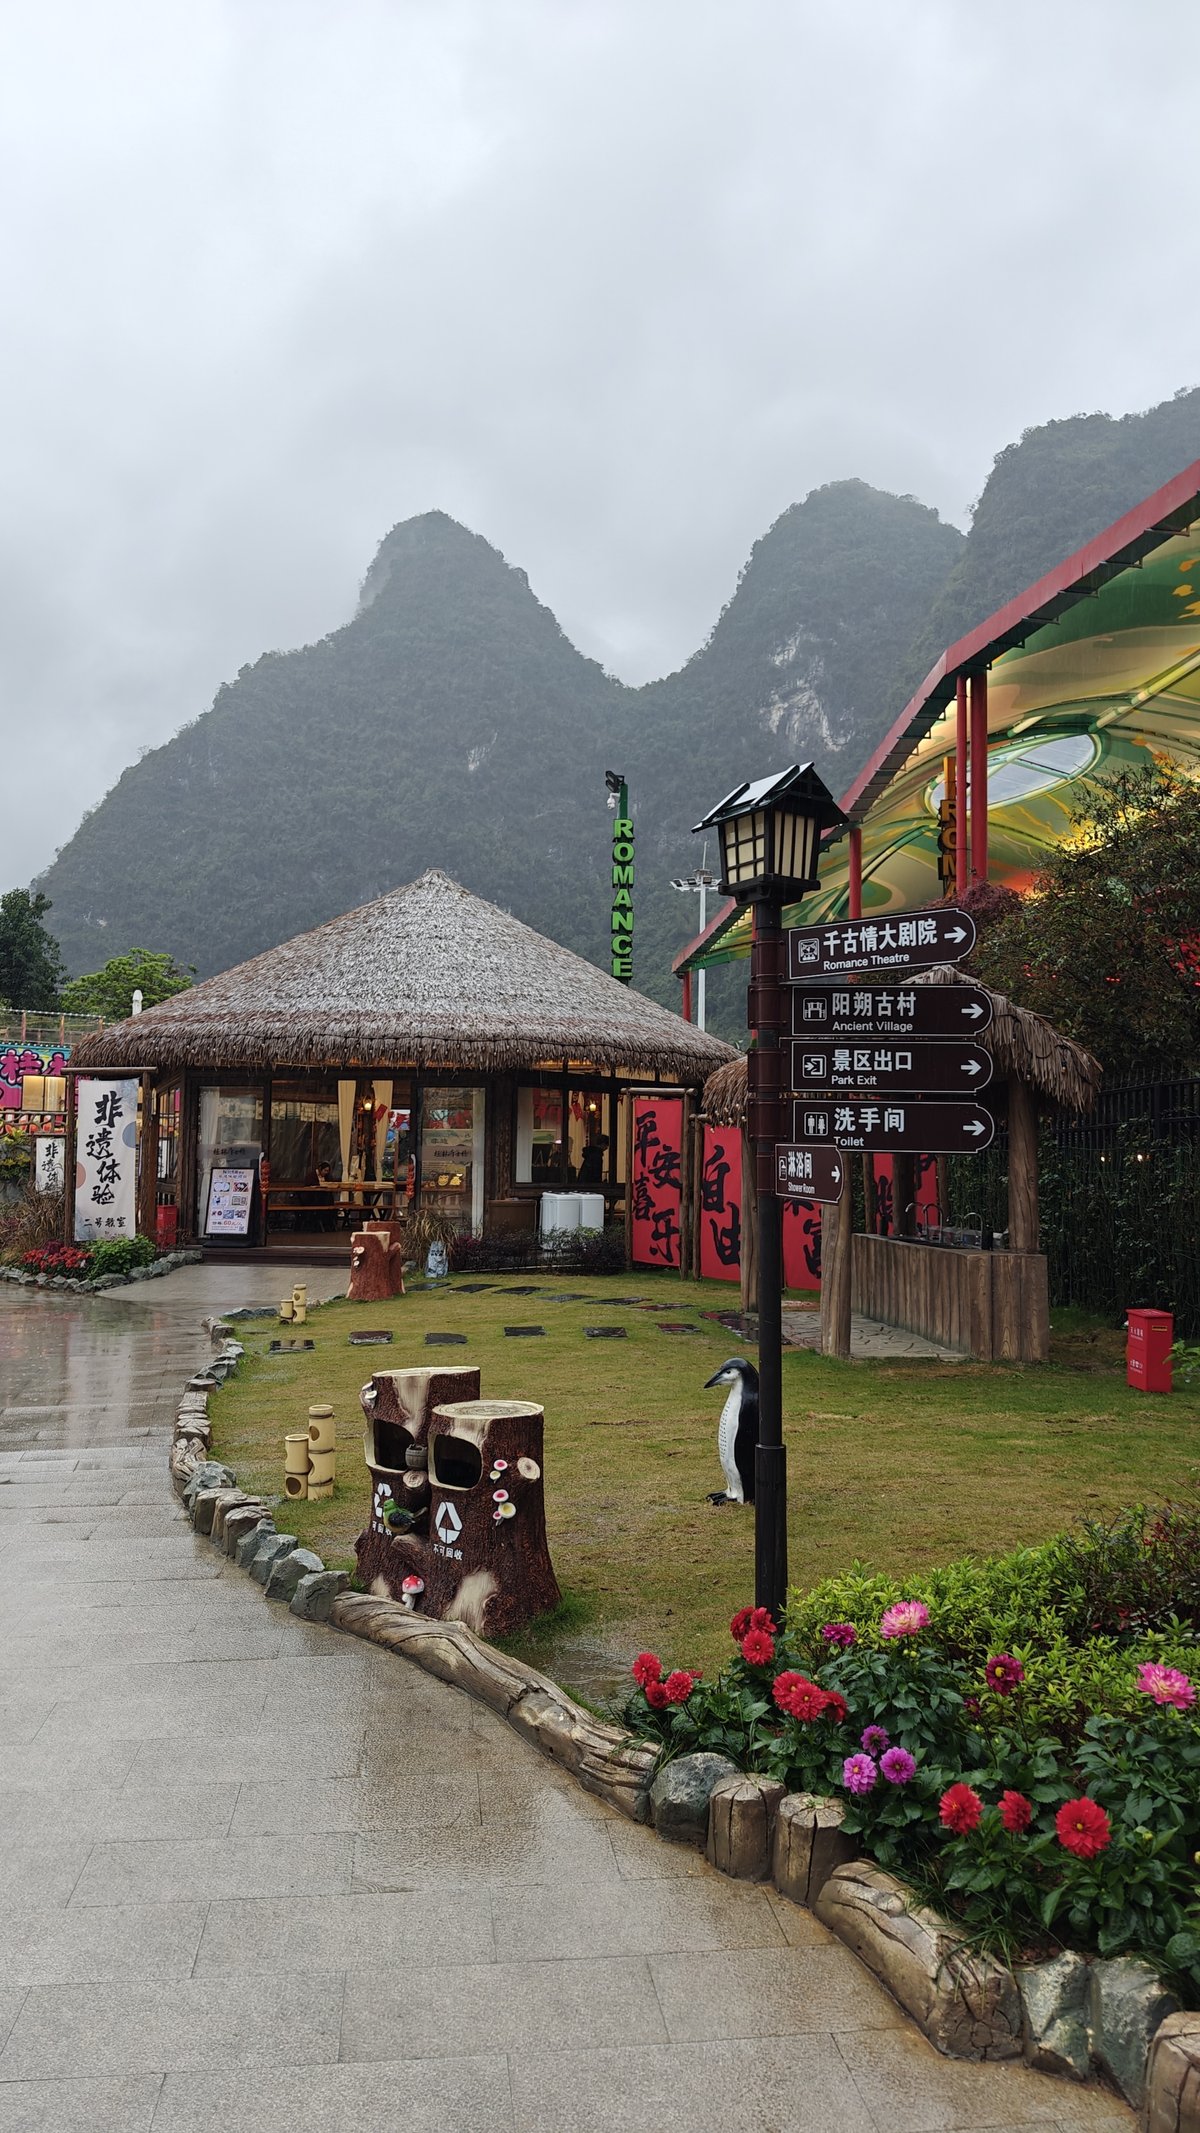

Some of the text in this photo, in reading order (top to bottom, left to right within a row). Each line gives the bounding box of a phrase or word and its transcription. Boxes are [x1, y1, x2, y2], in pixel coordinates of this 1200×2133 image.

[611, 818, 636, 978] ROMANCE
[823, 918, 938, 957] 千古情大剧院
[823, 952, 910, 971] Romance Theatre
[832, 992, 916, 1017] 阳朔古村
[832, 1020, 913, 1033] Ancient Village
[831, 1049, 912, 1072] 景区出口
[831, 1074, 877, 1086] Park Exit
[834, 1107, 905, 1132] 洗手间
[85, 1090, 124, 1205] 非遗体验
[834, 1136, 864, 1147] Toilet
[787, 1151, 813, 1179] 淋浴间
[633, 1110, 681, 1263] 平安喜乐
[83, 1216, 127, 1228] 二号教室
[372, 1520, 393, 1536] 可回收
[432, 1543, 463, 1561] 不可回收
